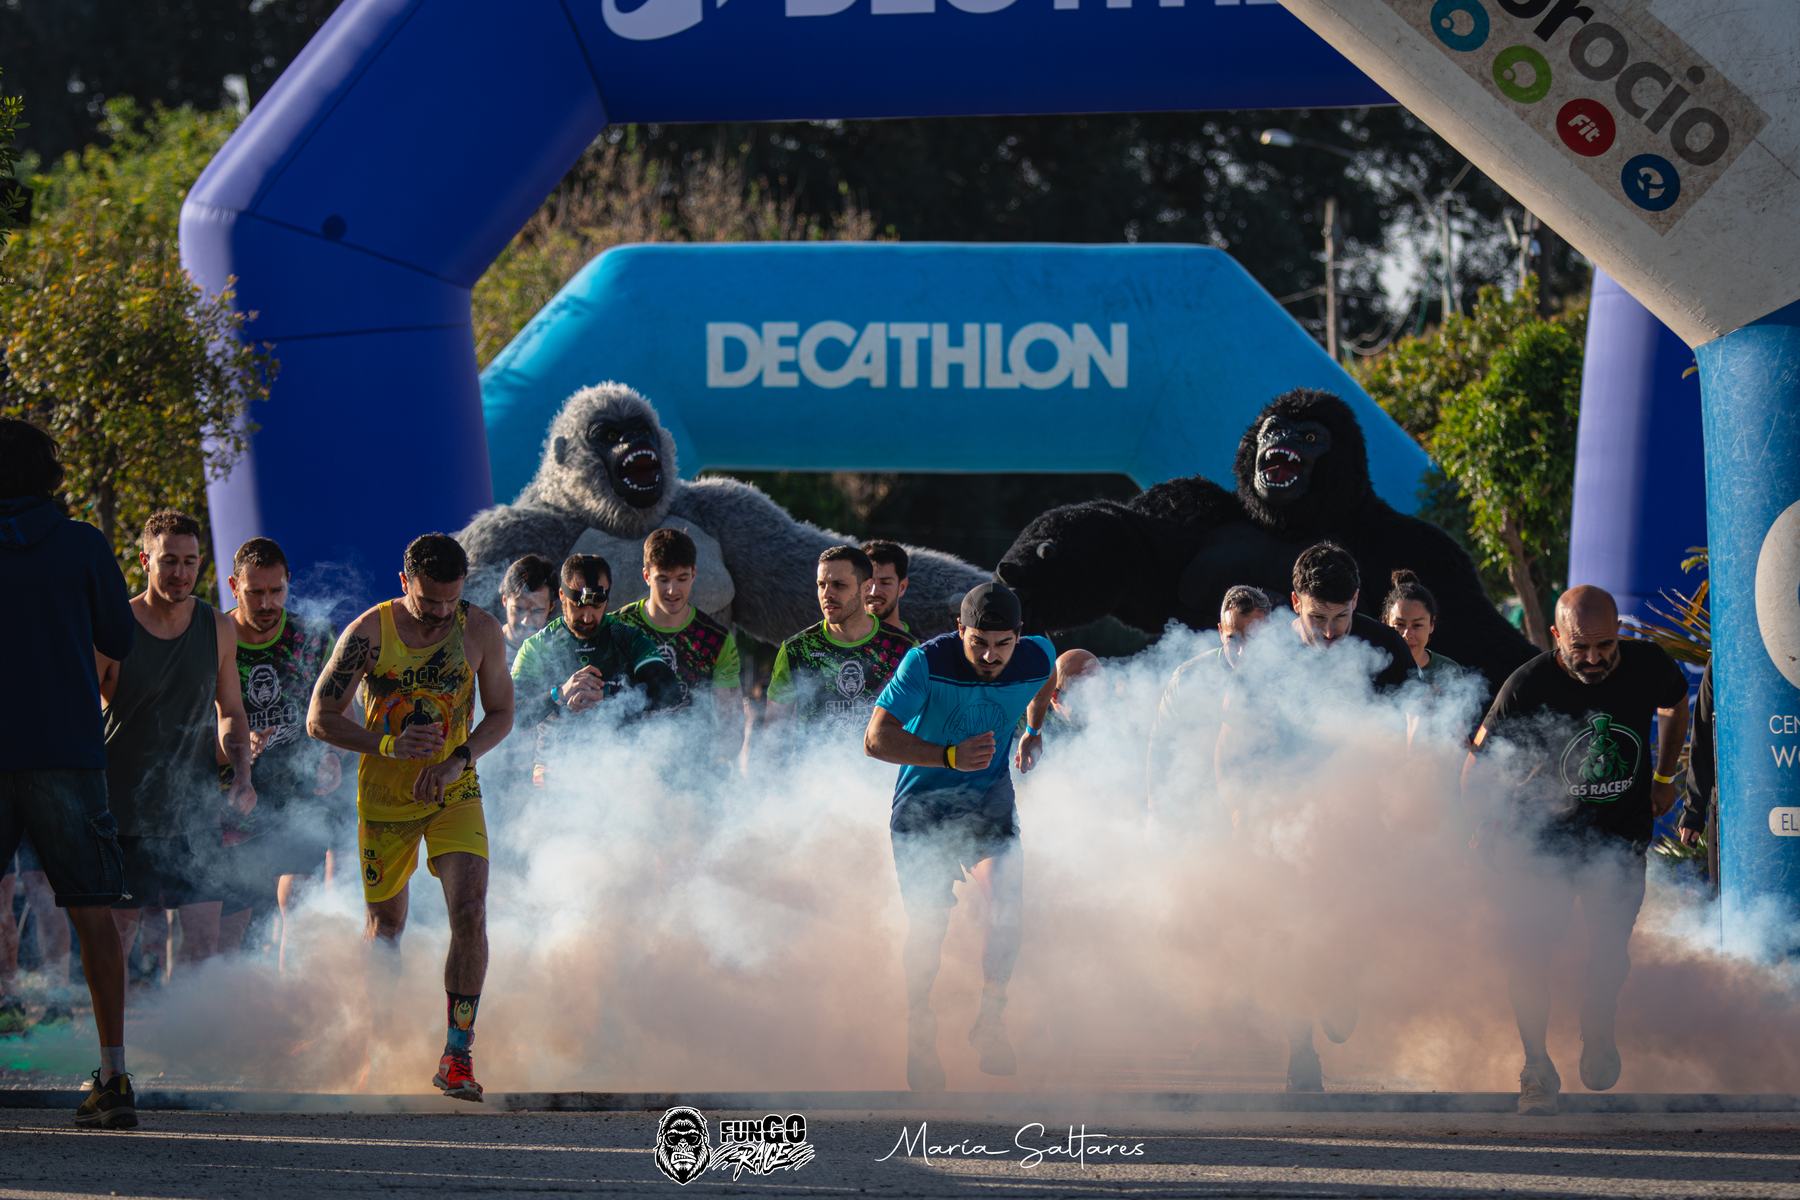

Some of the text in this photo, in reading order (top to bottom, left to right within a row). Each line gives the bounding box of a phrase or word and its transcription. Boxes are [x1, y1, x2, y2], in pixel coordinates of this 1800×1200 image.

[1567, 114, 1601, 143] Fit
[706, 320, 1129, 389] DECATHLON
[249, 703, 299, 728] UNGO
[1771, 745, 1800, 768] W
[1590, 776, 1633, 795] RACERS
